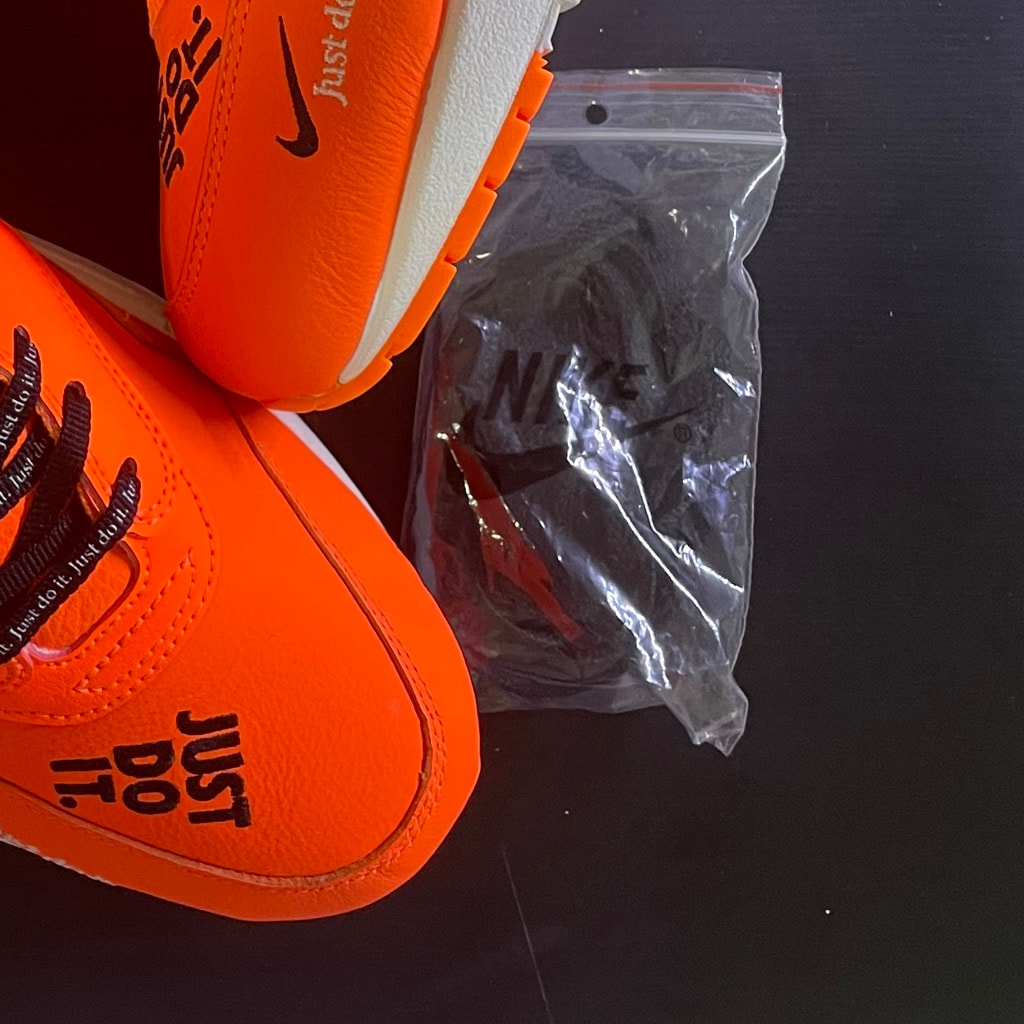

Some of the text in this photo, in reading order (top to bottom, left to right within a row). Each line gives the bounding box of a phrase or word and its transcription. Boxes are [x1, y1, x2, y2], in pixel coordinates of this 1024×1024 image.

[181, 4, 222, 86] IT.
[313, 33, 348, 108] Just
[165, 47, 199, 136] DO
[12, 390, 30, 412] do
[21, 371, 36, 387] it.
[9, 457, 34, 494] Just
[9, 609, 40, 641] Just
[38, 589, 57, 609] do
[53, 574, 73, 589] it.
[68, 543, 100, 576] Just
[97, 524, 118, 545] do
[112, 508, 129, 524] it.
[50, 756, 117, 809] IT.
[113, 739, 181, 815] DO
[176, 709, 252, 829] JUST
